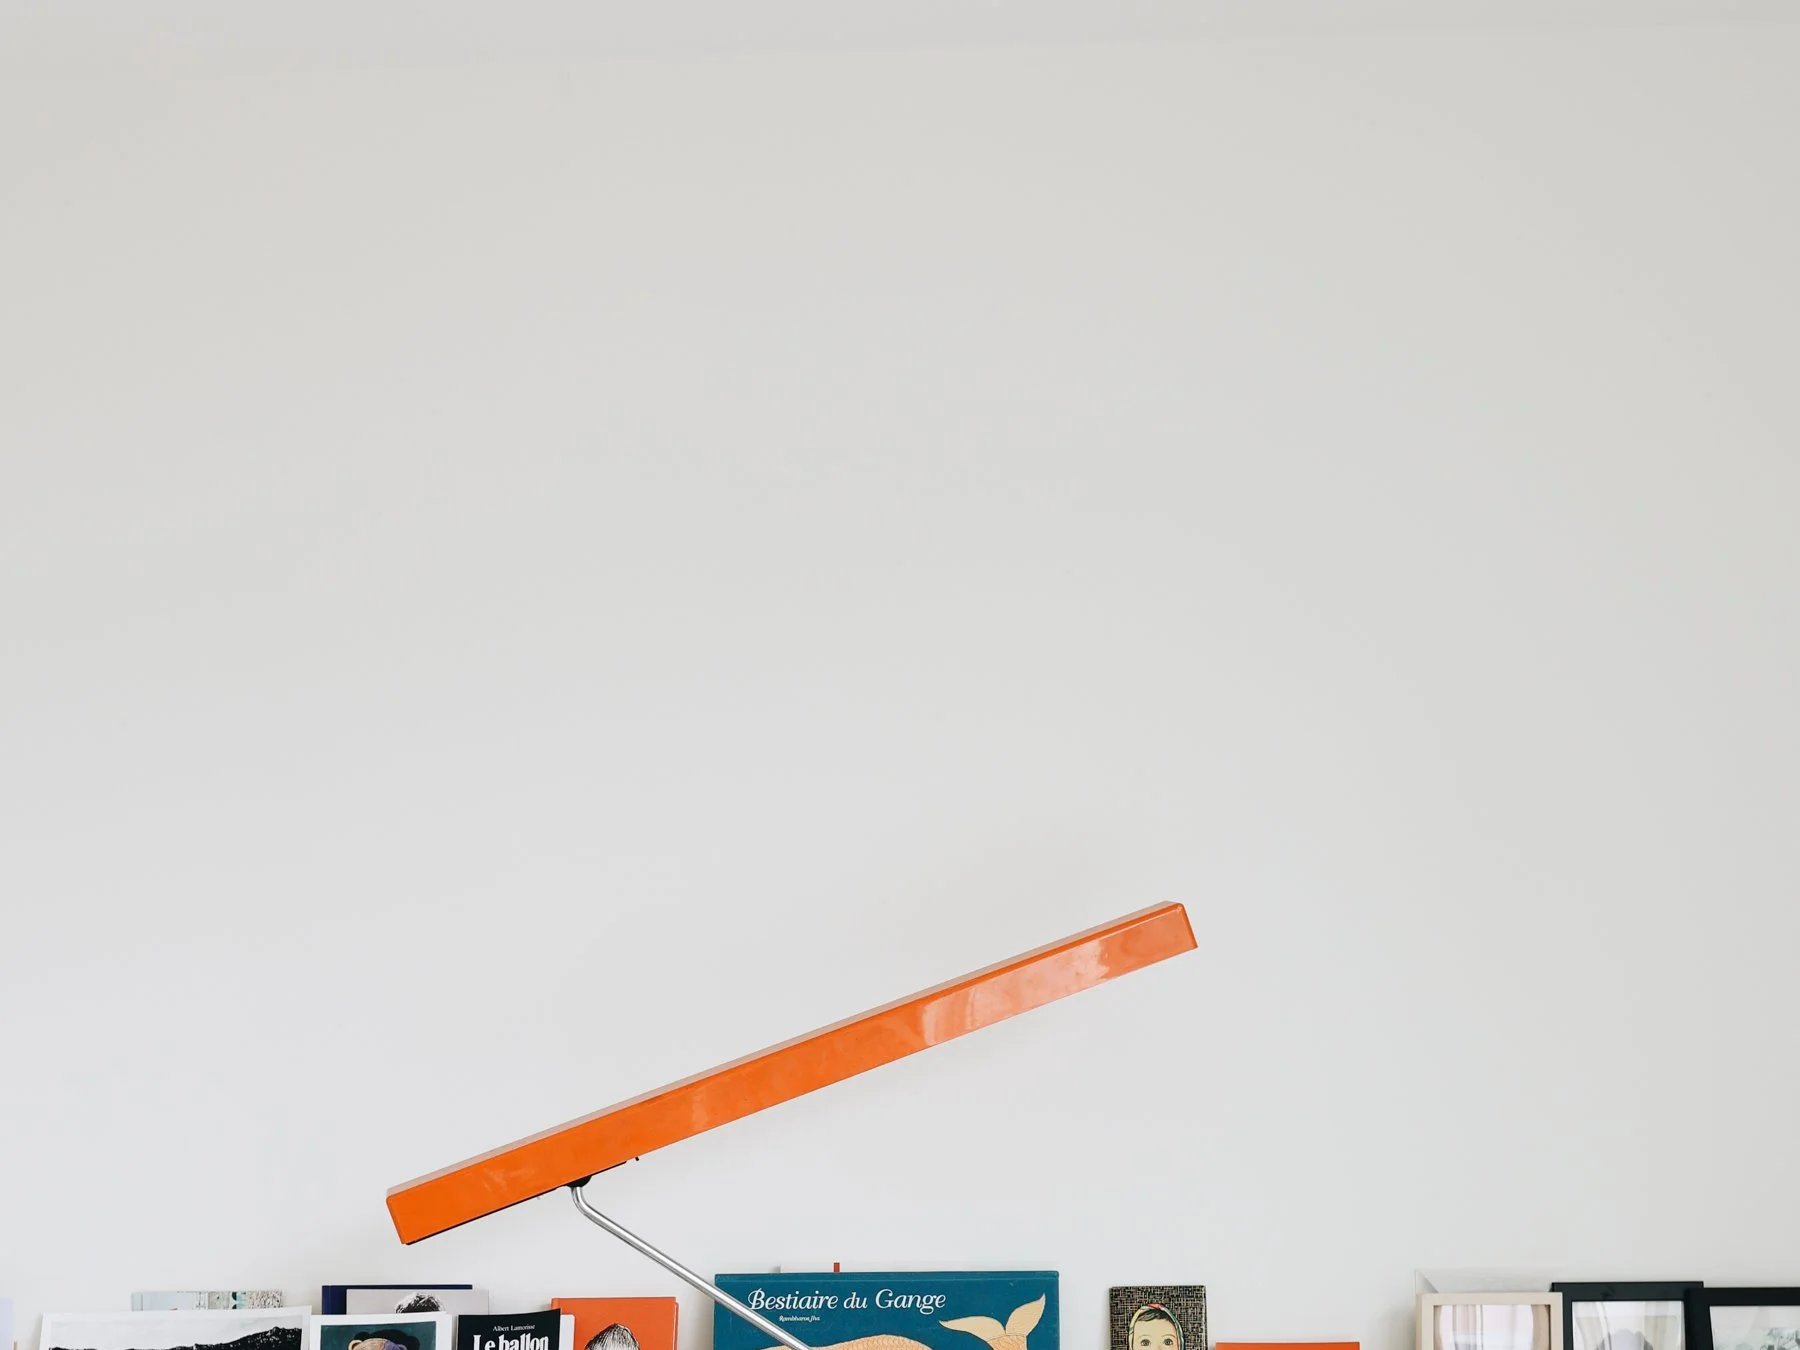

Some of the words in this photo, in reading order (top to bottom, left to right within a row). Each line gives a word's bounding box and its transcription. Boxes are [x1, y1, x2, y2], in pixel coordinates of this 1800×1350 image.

[748, 1288, 839, 1310] Bestiaire
[843, 1292, 868, 1309] du
[875, 1288, 946, 1315] Gange
